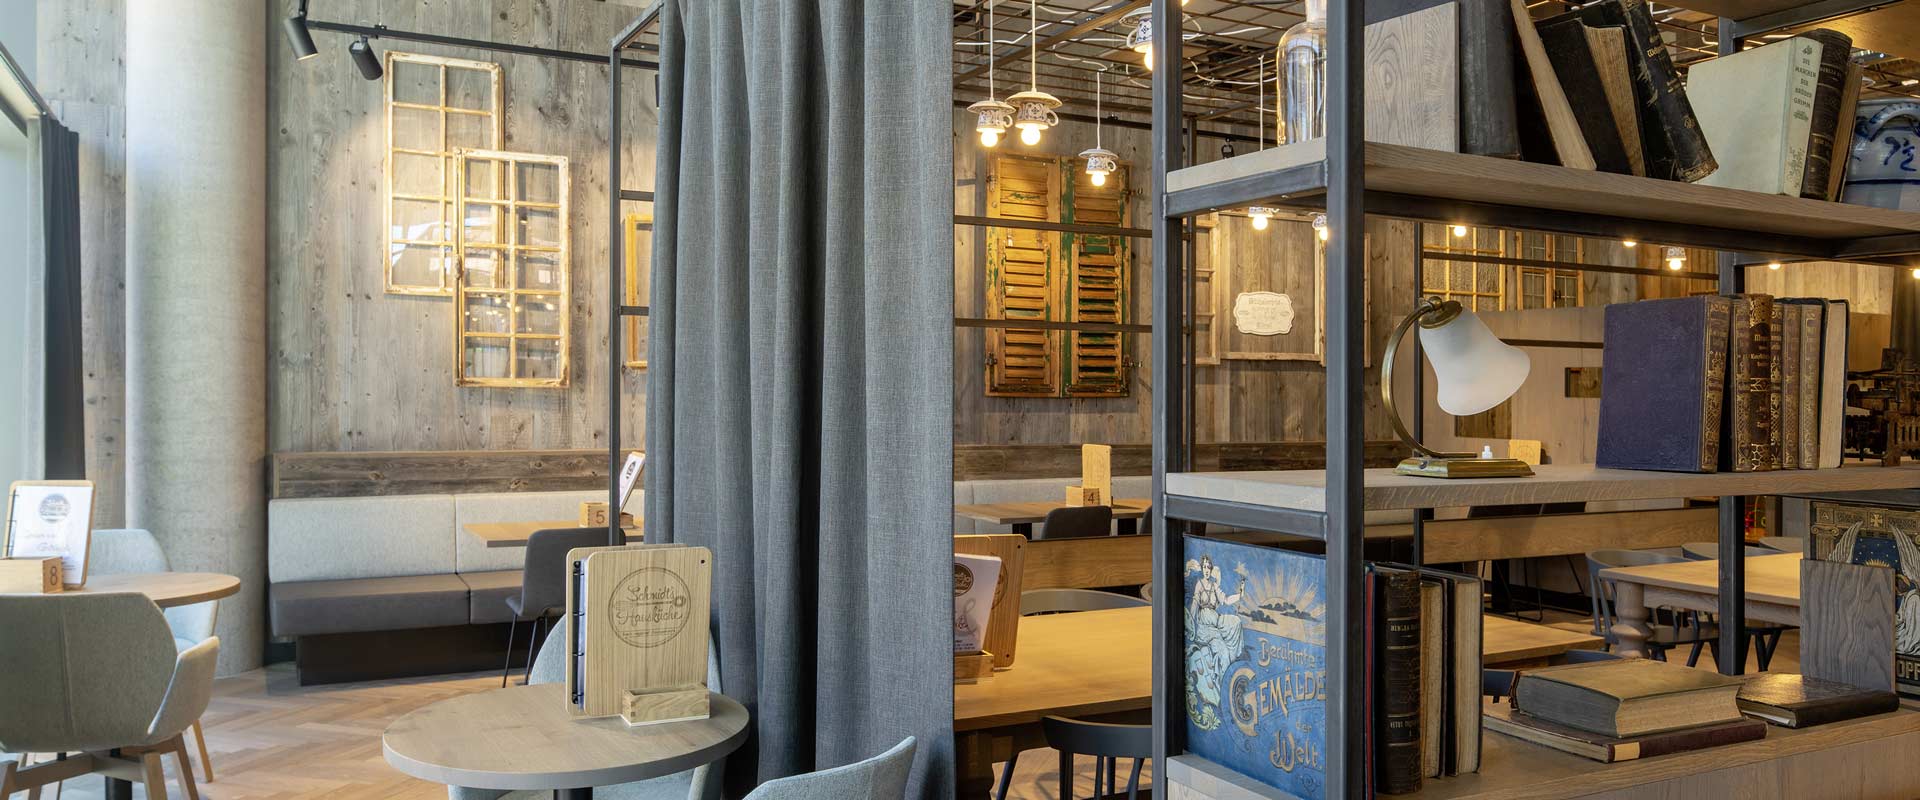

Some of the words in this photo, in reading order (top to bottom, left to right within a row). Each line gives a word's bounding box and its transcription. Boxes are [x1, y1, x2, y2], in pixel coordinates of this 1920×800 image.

[1793, 97, 1811, 109] GRIMM
[1087, 492, 1095, 505] 4
[595, 510, 605, 524] 5
[50, 566, 58, 586] 8
[626, 585, 675, 602] Schmidt's
[1257, 637, 1315, 668] Berühmte
[1229, 666, 1326, 737] GEMÄLDE
